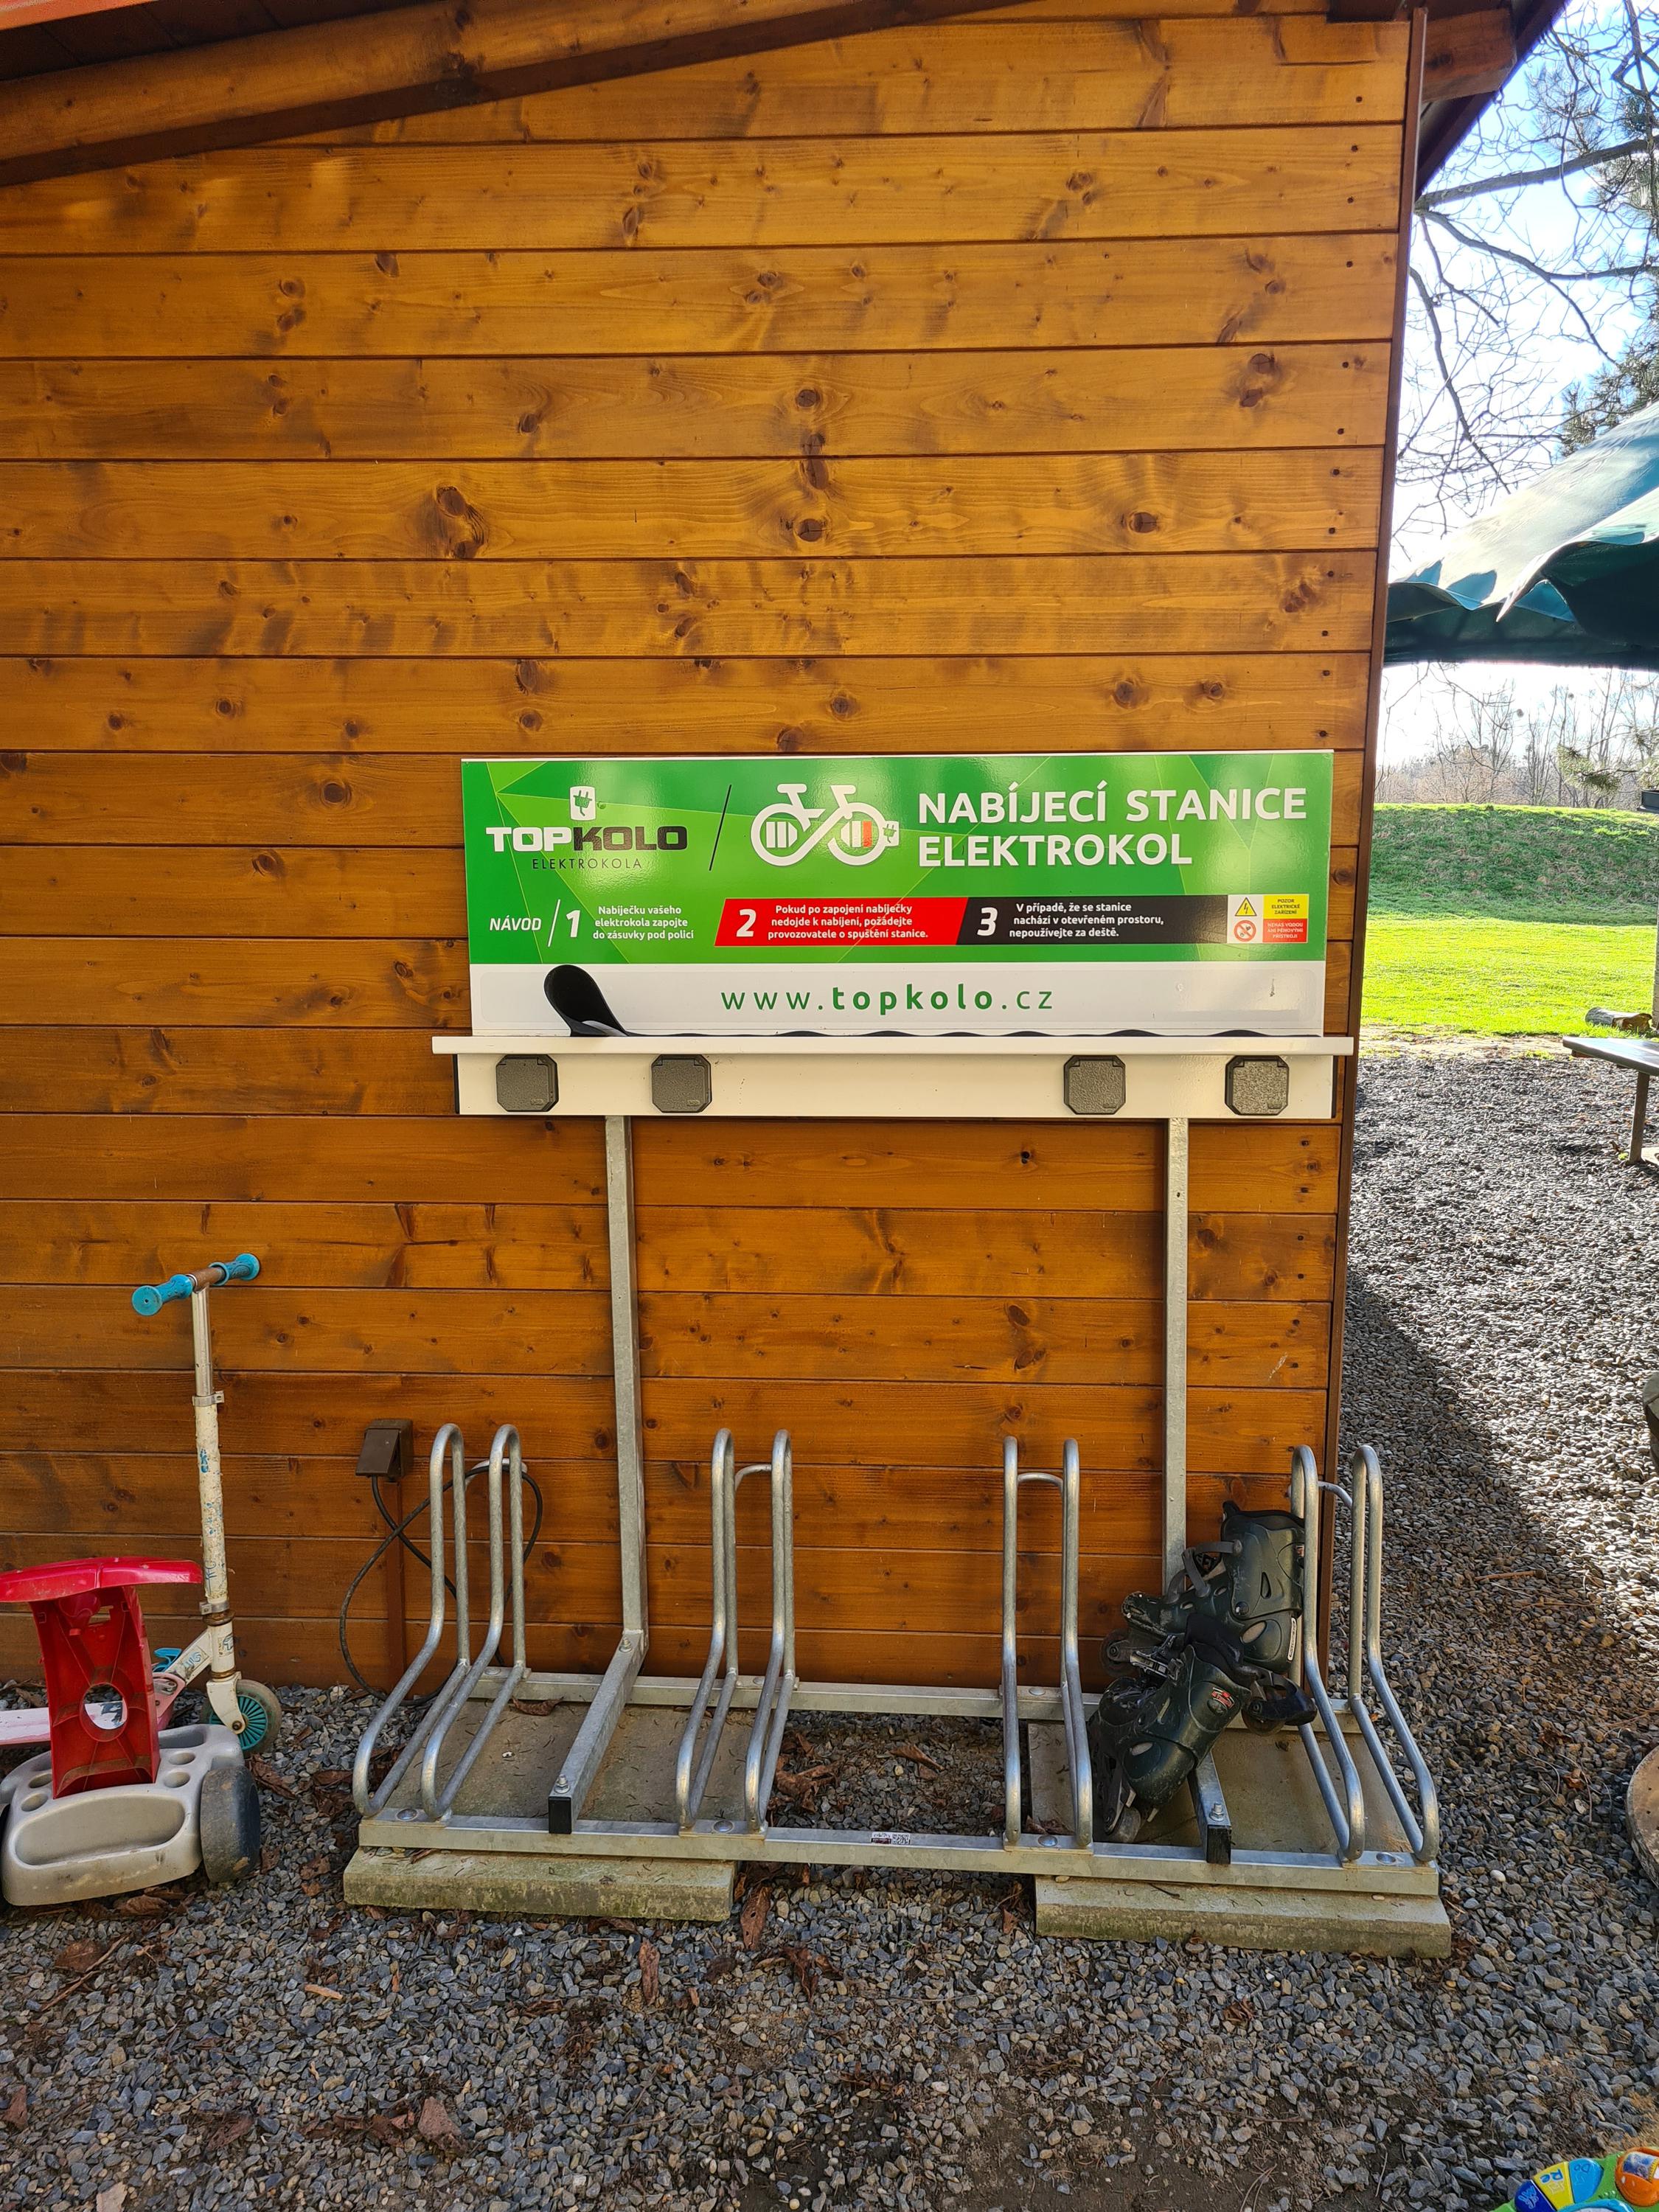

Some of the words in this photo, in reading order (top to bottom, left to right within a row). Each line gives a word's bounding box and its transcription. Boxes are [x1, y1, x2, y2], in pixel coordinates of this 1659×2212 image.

[919, 779, 1107, 824] NABÍJECÍ
[1126, 787, 1307, 822] STANICE
[485, 826, 687, 852] TOPKOLO
[919, 833, 1192, 867] ELEKTROKOL
[532, 858, 642, 870] ELEKTROKOLA
[598, 905, 646, 917] Nabíječku
[647, 905, 682, 915] vašeho
[775, 904, 807, 914] Pokud
[808, 906, 821, 916] po
[822, 904, 864, 916] zapojení
[866, 903, 913, 915] nabíječky
[1016, 903, 1025, 913] V
[1026, 902, 1067, 914] případě,
[1068, 902, 1081, 912] že
[1082, 904, 1094, 912] se
[1095, 902, 1133, 912] stanice
[489, 914, 542, 931] NÁVOD
[566, 909, 581, 938] 1
[594, 917, 650, 928] elektrokola
[652, 917, 689, 929] zapojte
[736, 908, 757, 937] 2
[771, 917, 810, 928] nedojde
[813, 917, 819, 926] k
[864, 916, 913, 928] požádejte
[976, 906, 998, 936] 3
[1013, 915, 1051, 925] nachází
[1060, 914, 1116, 925] otevřeném
[1117, 915, 1164, 926] prostoru,
[593, 930, 605, 939] do
[607, 930, 645, 941] zásuvky
[647, 930, 666, 941] pod
[667, 929, 695, 941] policí
[768, 929, 837, 941] provozovatele
[847, 929, 889, 940] spuštění
[891, 928, 929, 938] stanice.
[1009, 928, 1074, 939] nepoužívejte
[1074, 929, 1087, 937] za
[1088, 927, 1120, 937] deště.
[720, 983, 1053, 1016] www.topkolo.cz
[1573, 2163, 1591, 2174] Do
[1540, 2168, 1564, 2184] Re
